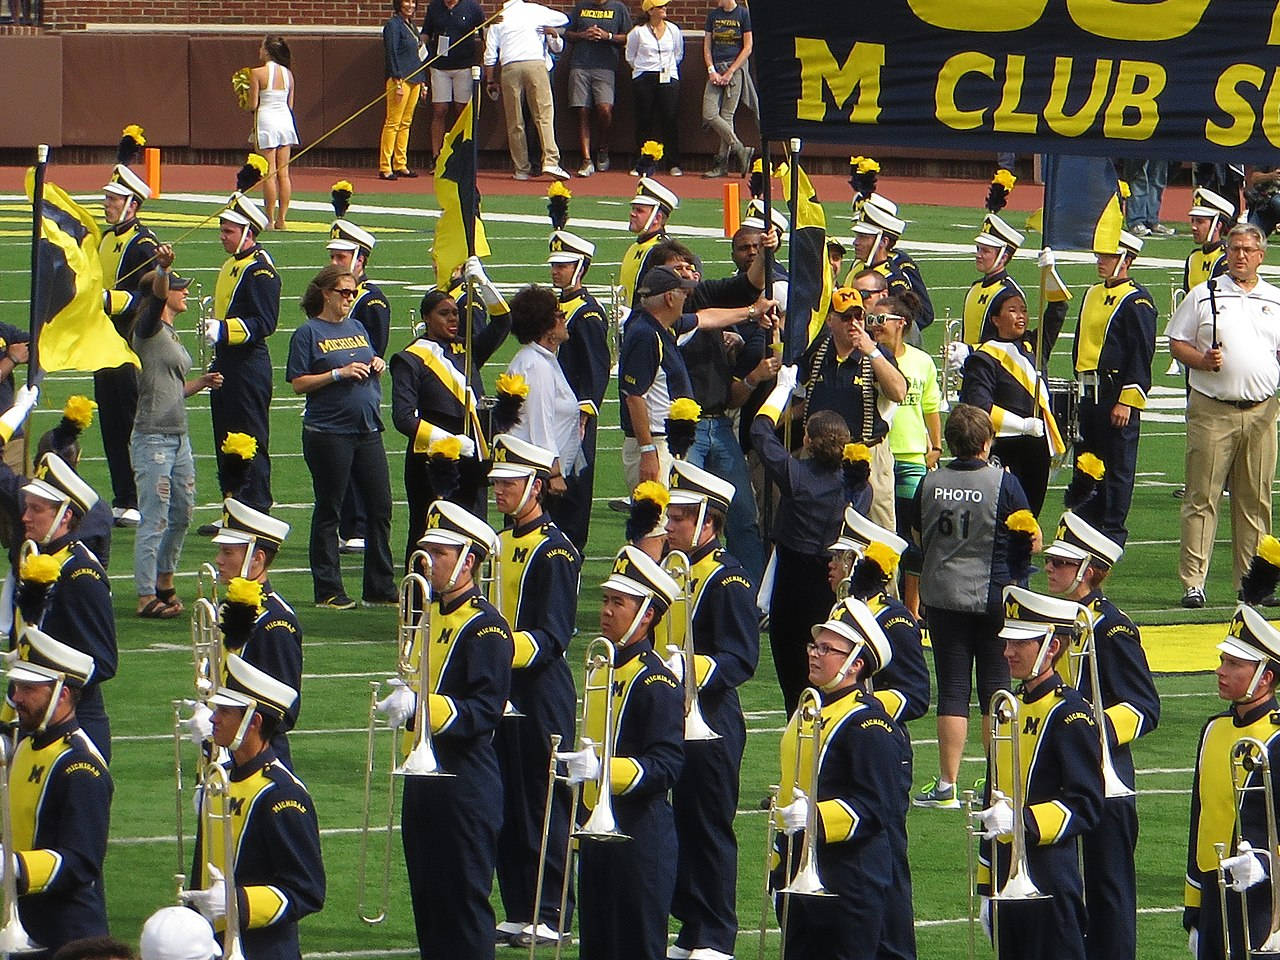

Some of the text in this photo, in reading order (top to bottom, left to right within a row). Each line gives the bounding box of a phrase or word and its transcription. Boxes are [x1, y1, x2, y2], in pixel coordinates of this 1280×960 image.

[796, 37, 887, 123] M
[935, 53, 1168, 142] CLUB
[318, 336, 369, 353] MICHIGAN
[934, 487, 983, 503] PHOTO
[938, 512, 974, 539] 61
